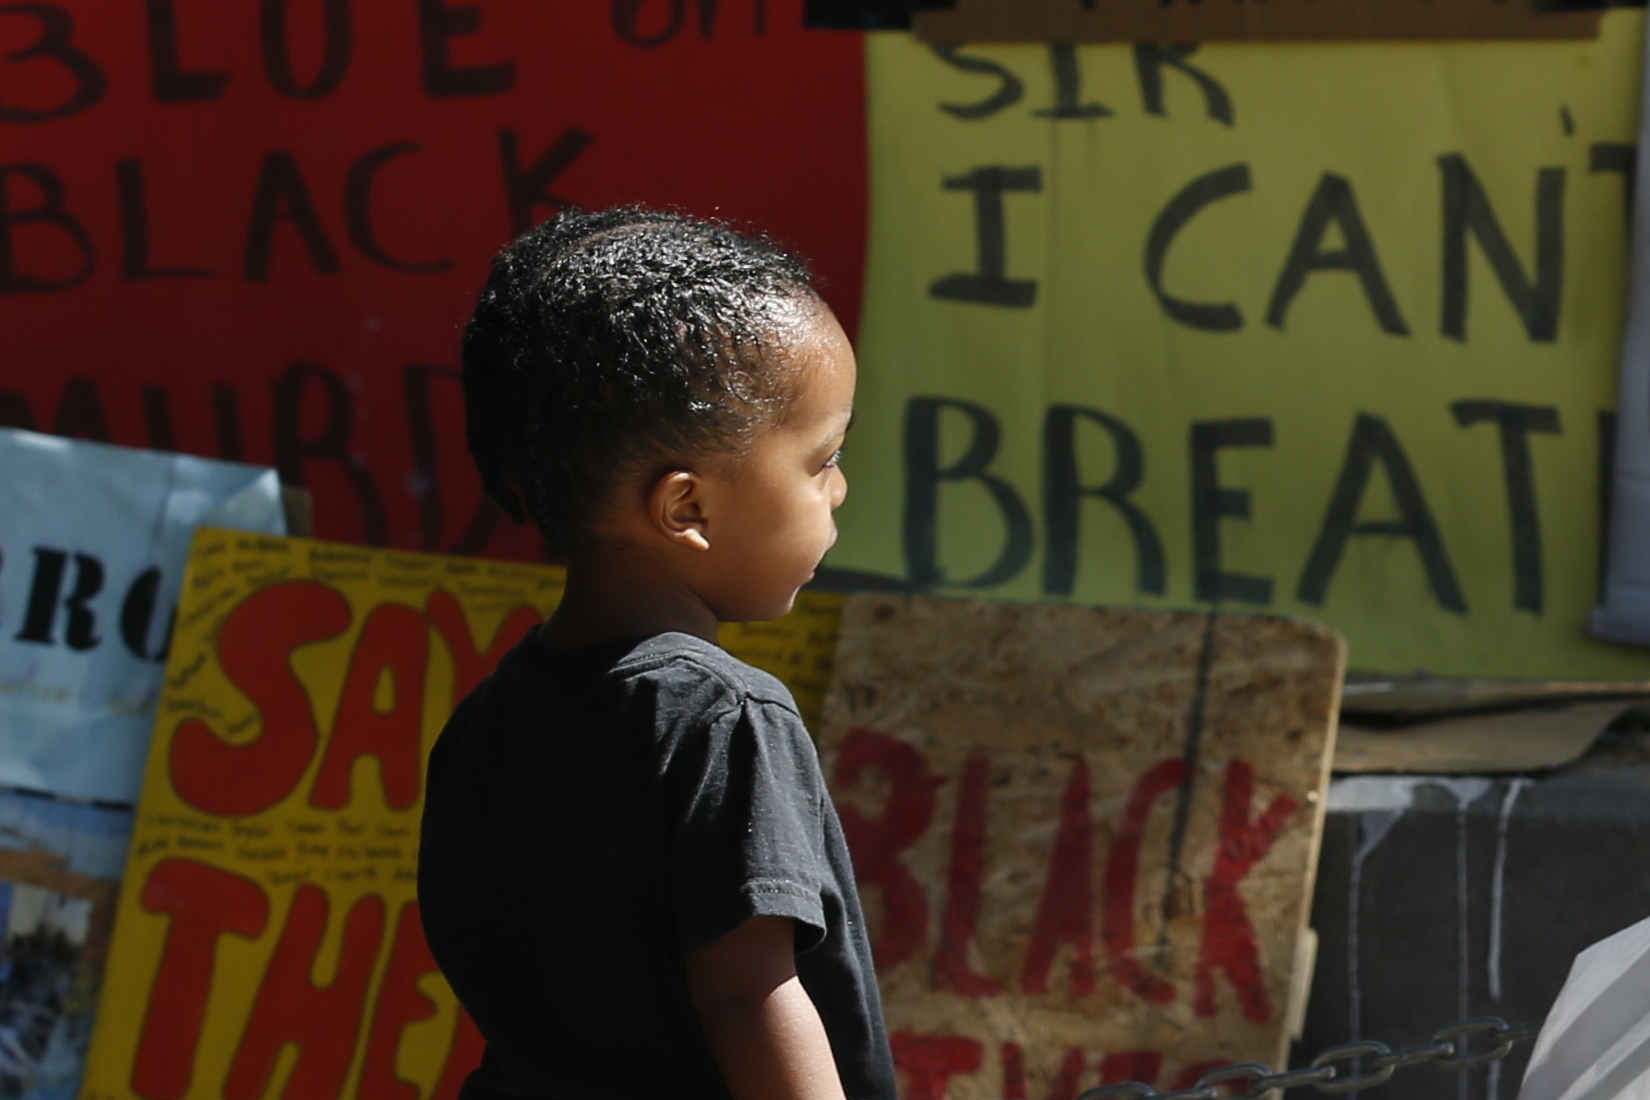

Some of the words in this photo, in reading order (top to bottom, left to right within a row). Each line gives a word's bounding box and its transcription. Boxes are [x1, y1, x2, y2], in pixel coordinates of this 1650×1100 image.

[0, 128, 595, 294] BLACK
[928, 165, 1042, 308] I
[902, 395, 1617, 617] BREAT
[0, 545, 180, 664] RO
[832, 728, 1298, 1025] BLACK
